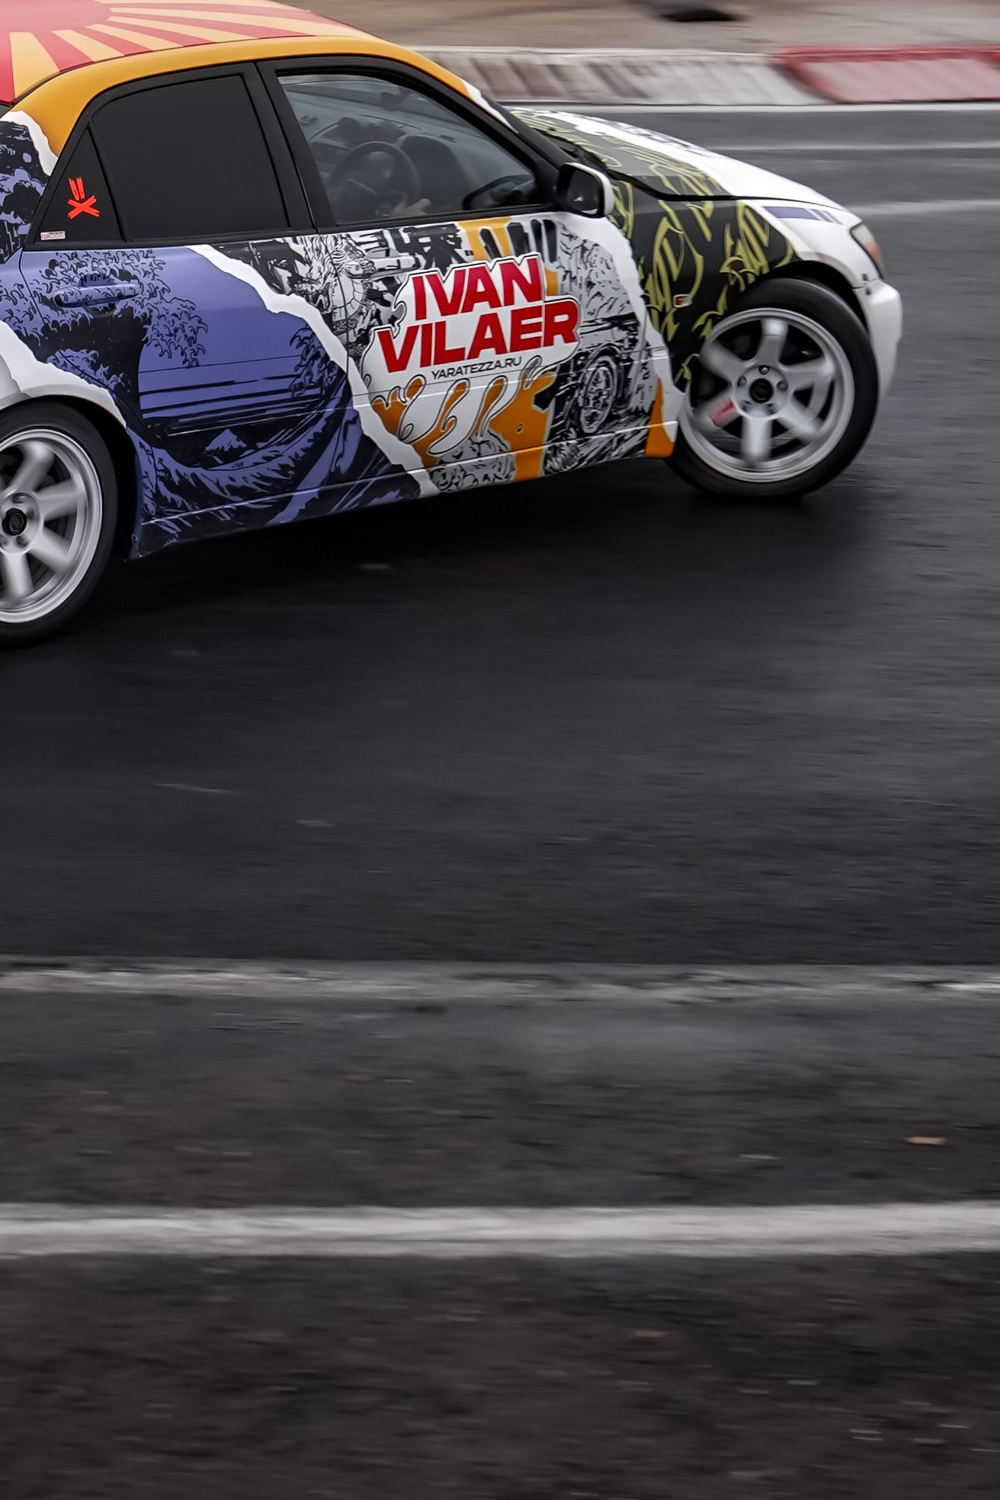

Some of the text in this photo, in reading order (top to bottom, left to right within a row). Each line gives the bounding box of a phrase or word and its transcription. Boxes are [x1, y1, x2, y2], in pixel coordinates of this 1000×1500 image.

[411, 258, 542, 320] IVAN
[376, 300, 579, 373] VILAER
[431, 356, 523, 380] YARATEZZA.RU
